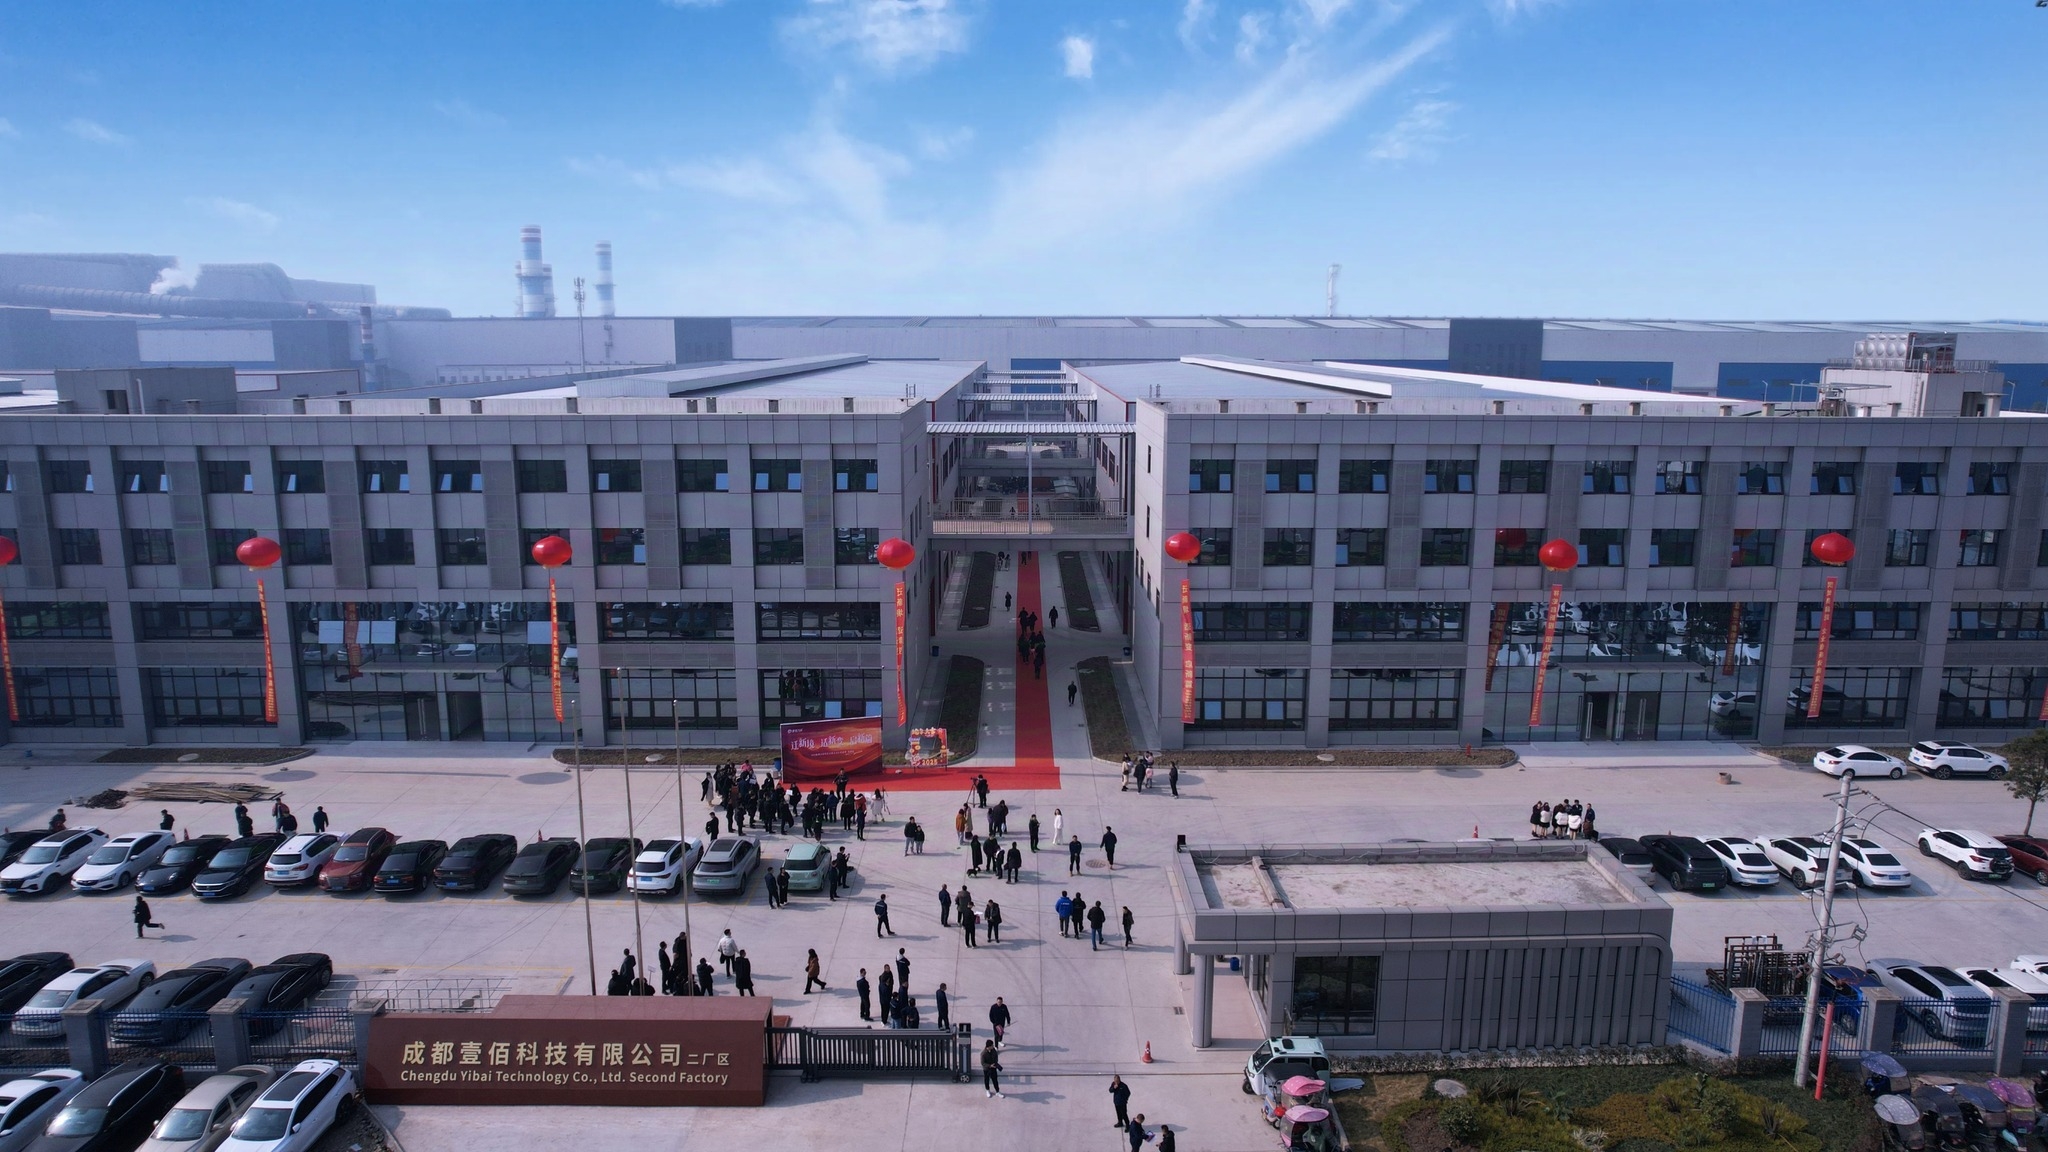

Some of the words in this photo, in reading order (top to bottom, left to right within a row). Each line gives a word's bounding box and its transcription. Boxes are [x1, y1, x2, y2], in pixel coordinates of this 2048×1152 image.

[402, 1041, 680, 1066] 成都壹佰科技有限公司
[687, 1053, 729, 1066] 二厂区
[401, 1070, 456, 1084] Chengdu
[461, 1071, 491, 1081] Yibai
[496, 1071, 569, 1085] Technology
[573, 1072, 597, 1084] Co.,
[602, 1071, 625, 1083] Ltd.
[630, 1072, 675, 1082] Second
[680, 1072, 728, 1085] Factory
